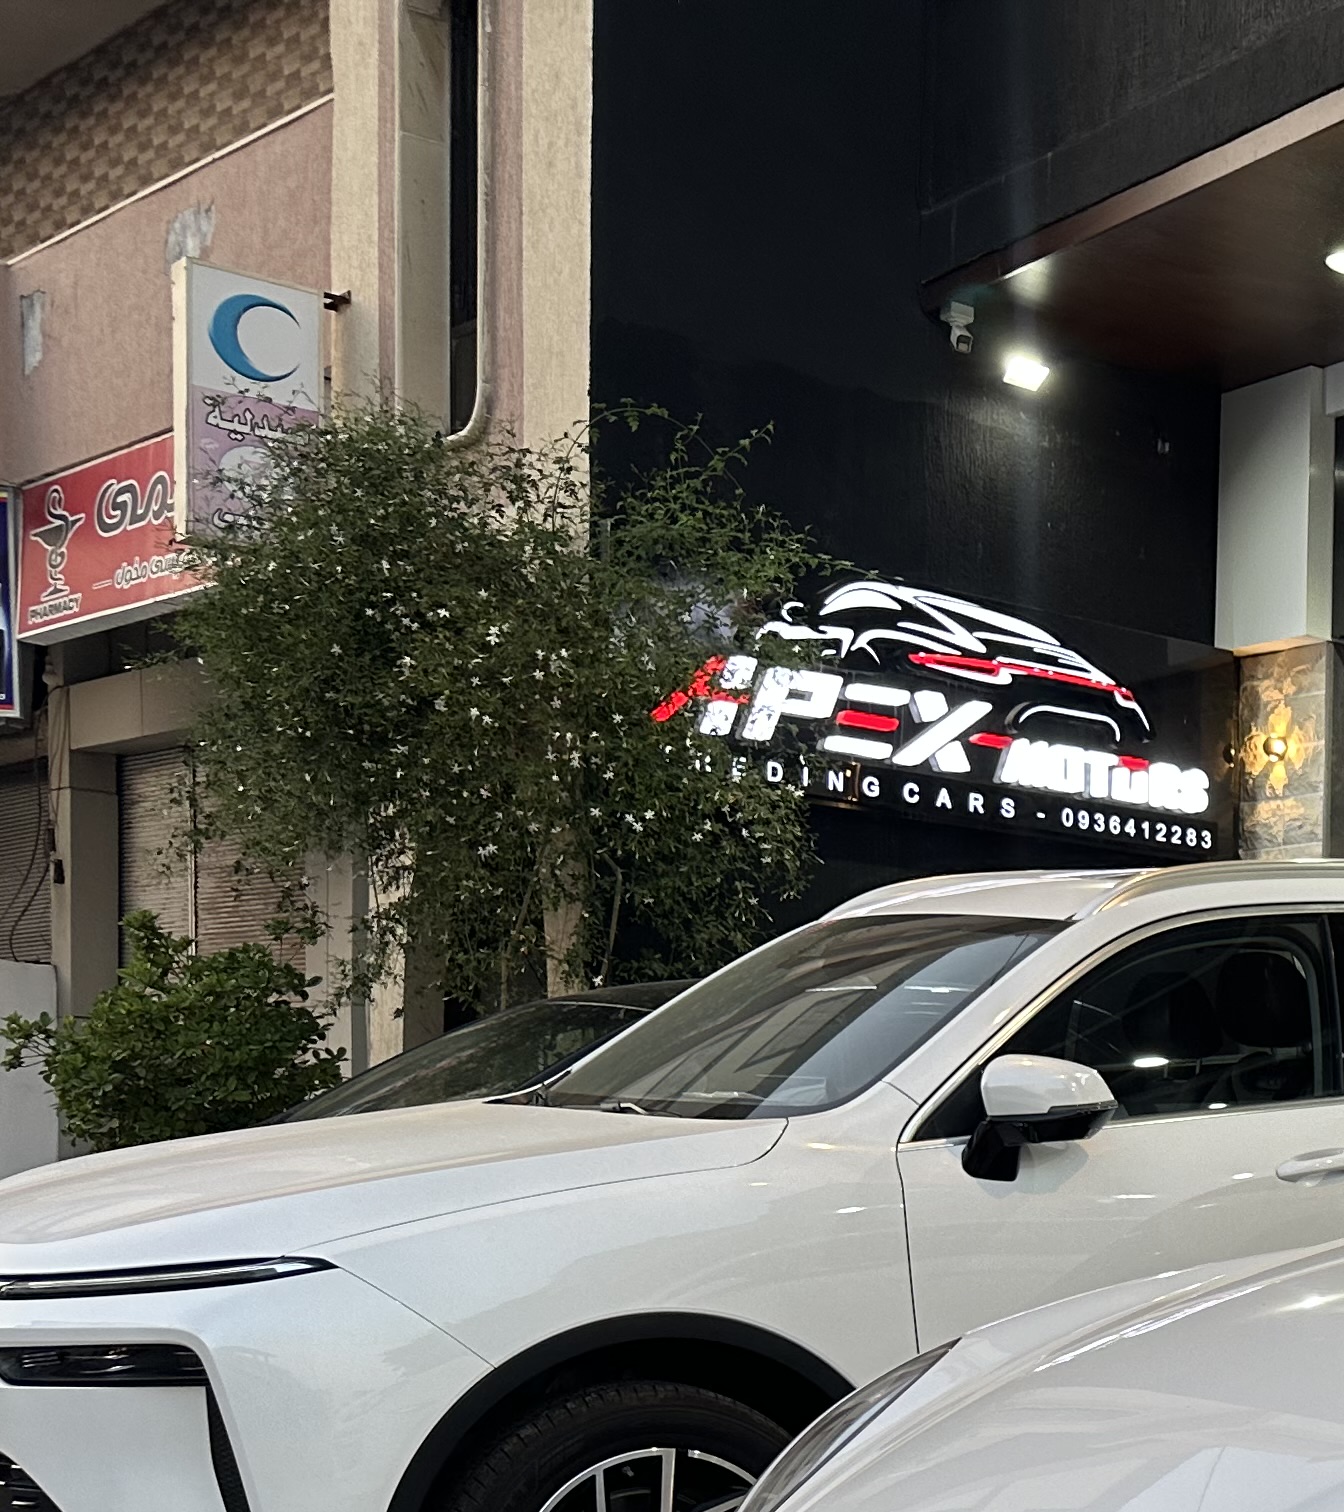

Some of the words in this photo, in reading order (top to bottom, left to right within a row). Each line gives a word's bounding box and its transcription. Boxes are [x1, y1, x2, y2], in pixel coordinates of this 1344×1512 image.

[28, 593, 82, 624] PHARMACY
[903, 781, 1015, 819] CARS
[1060, 806, 1213, 850] 0936412283
